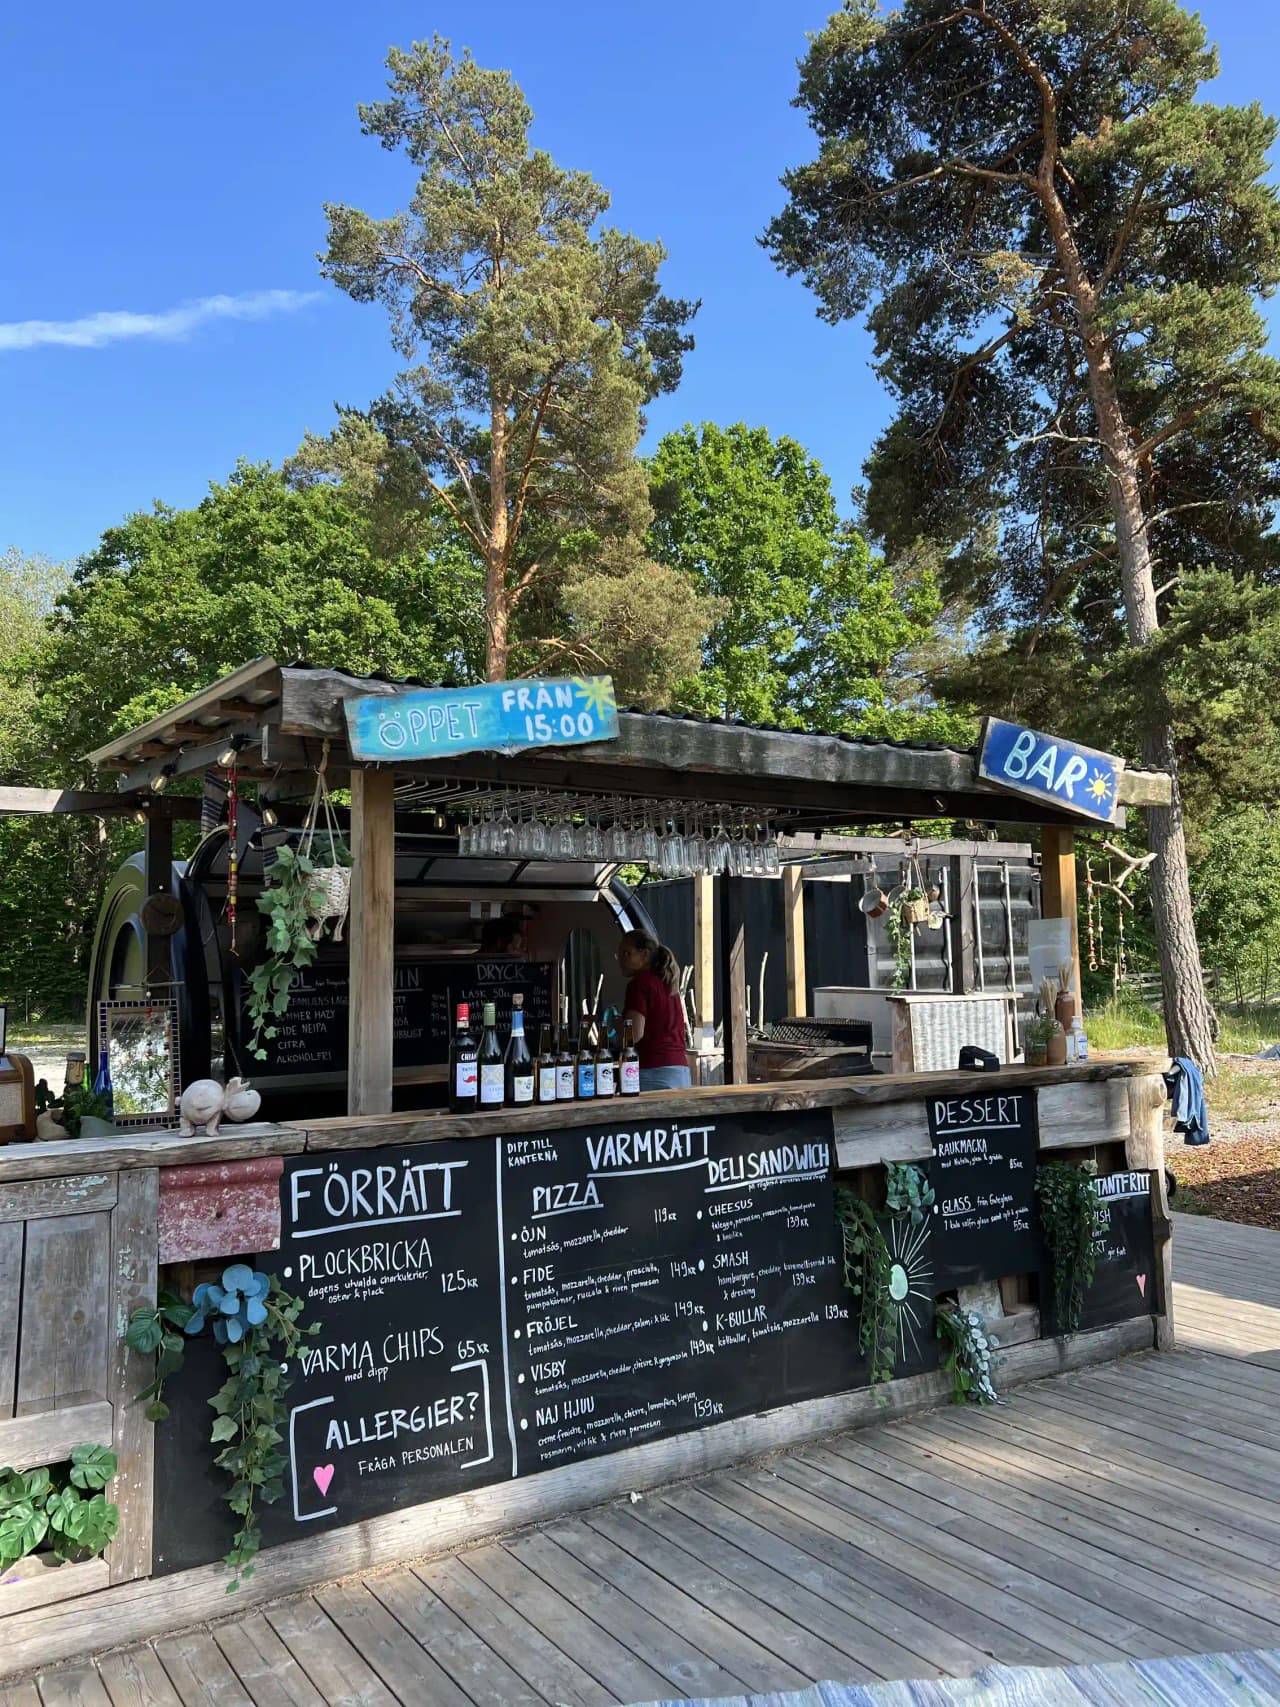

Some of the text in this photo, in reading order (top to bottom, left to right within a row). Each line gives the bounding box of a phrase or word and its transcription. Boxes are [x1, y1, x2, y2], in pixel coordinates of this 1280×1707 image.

[502, 682, 572, 712] FRÅN
[378, 701, 482, 750] ÖPPET
[525, 712, 594, 741] 15:00
[1003, 730, 1088, 799] BAR
[476, 964, 526, 981] DRYCK
[314, 1010, 336, 1020] HAZY
[276, 1022, 328, 1036] FIDE NEIPA
[277, 1040, 306, 1050] CITRA
[276, 1050, 332, 1064] ALKOHOLFRI
[935, 1096, 1022, 1126] DESSERT
[507, 1138, 552, 1154] DIPP TILL
[586, 1124, 716, 1171] VARMRÄTT
[938, 1138, 987, 1157] RAUKMACKA
[508, 1150, 558, 1168] KANTERNA
[290, 1160, 470, 1222] FÖRRÄTT
[532, 1180, 600, 1212] PIZZA
[708, 1198, 753, 1216] CHEESUS
[942, 1196, 971, 1214] GLASS
[300, 1238, 433, 1282] PLOCKBRICKA
[712, 1251, 749, 1269] SMASH
[523, 1264, 555, 1286] FIDE
[308, 1282, 340, 1300] dagens
[716, 1304, 768, 1331] K-BULLAR
[300, 1340, 374, 1376] VARMA
[383, 1326, 444, 1363] CHIPS
[344, 1366, 389, 1383] med dipp
[530, 1360, 566, 1382] VISBY
[325, 1392, 480, 1450] ALLERGIER?
[536, 1404, 559, 1428] NAJ
[358, 1436, 474, 1476] FRÅGA PERSONALEN
